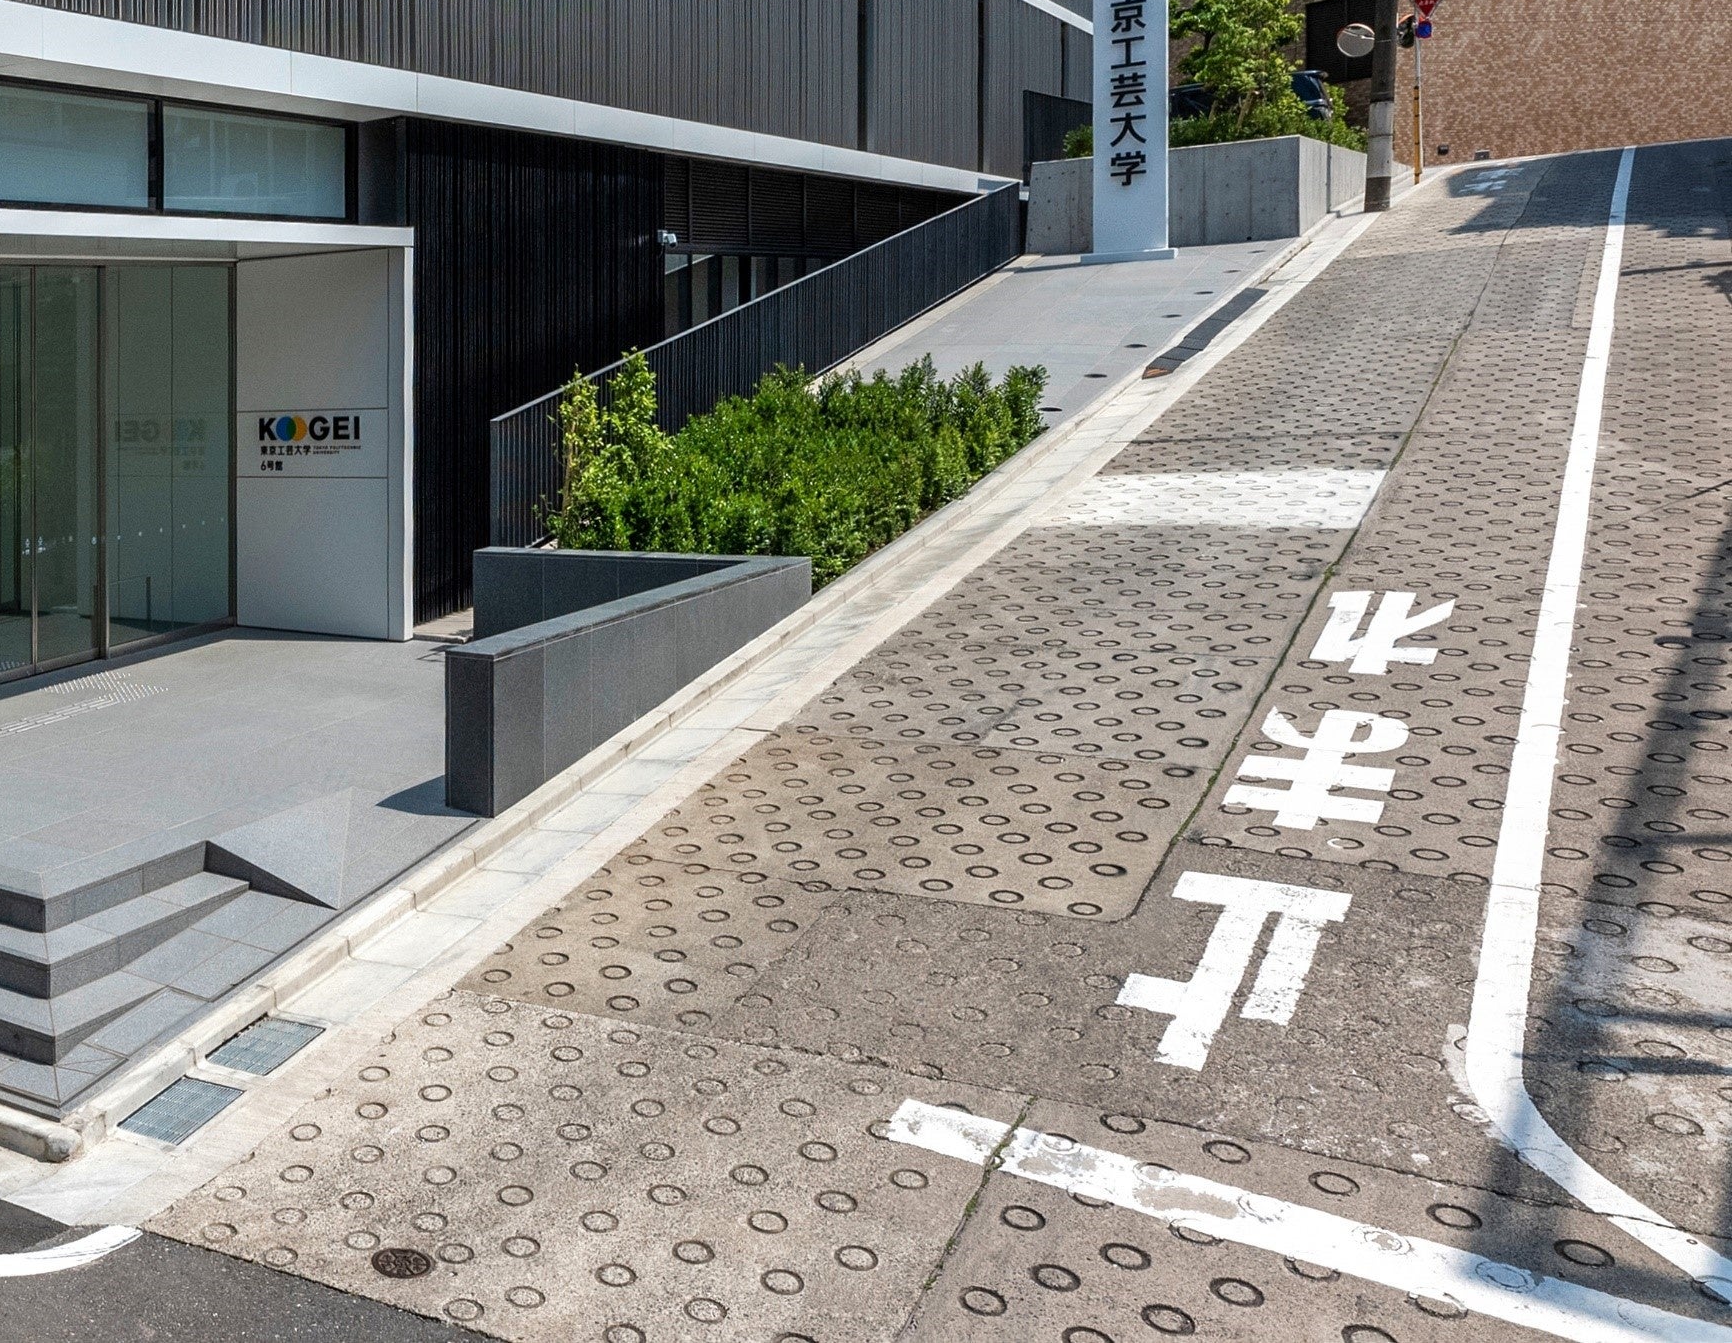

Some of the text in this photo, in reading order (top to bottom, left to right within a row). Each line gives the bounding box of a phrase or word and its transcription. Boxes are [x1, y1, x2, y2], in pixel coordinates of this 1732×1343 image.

[260, 445, 311, 456] 東京工芸大学
[1115, 590, 1456, 1072] 止まれ
